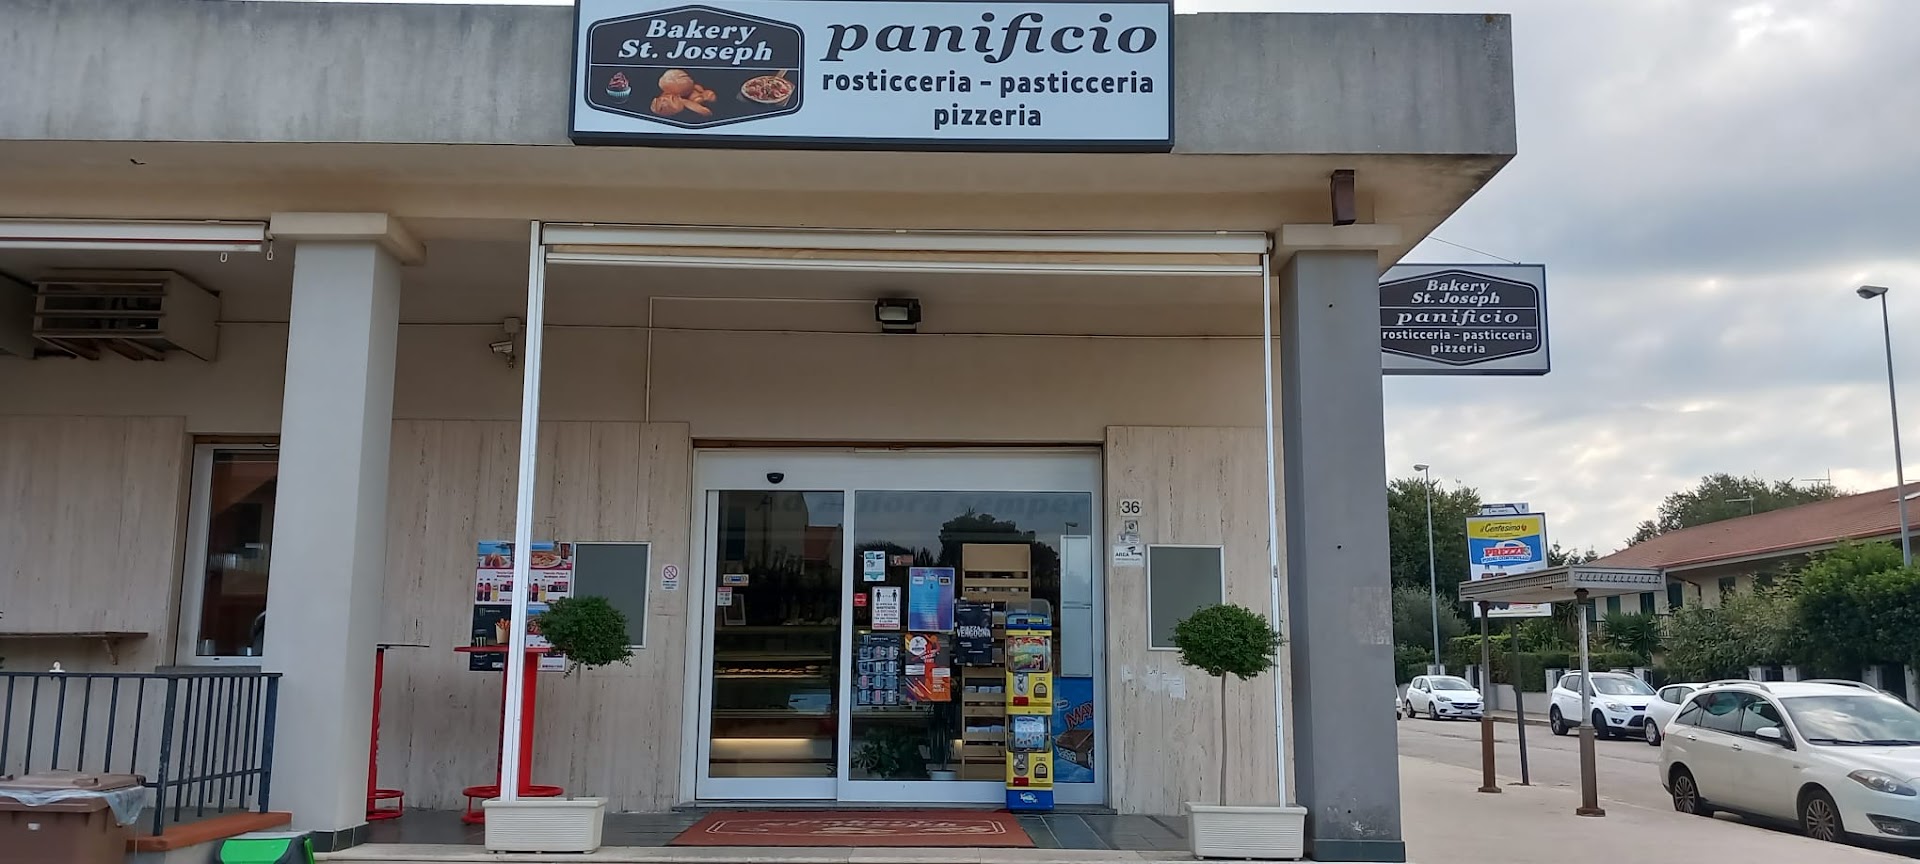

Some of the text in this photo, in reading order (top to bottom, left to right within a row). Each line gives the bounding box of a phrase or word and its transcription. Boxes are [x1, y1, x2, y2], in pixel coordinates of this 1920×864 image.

[646, 19, 756, 44] Bakery
[820, 12, 1158, 64] panificio
[618, 39, 773, 65] St. Joseph
[822, 70, 972, 93] rosticceria
[999, 71, 1155, 97] pasticceria
[934, 103, 1042, 129] pizzeria
[1427, 279, 1490, 295] Bakery
[1411, 292, 1500, 306] St. Joseph
[1396, 309, 1519, 326] panificio
[1382, 329, 1451, 340] rosticceria
[1463, 330, 1532, 341] pasticceria
[1431, 343, 1486, 354] pizzeria
[1121, 501, 1140, 514] 36
